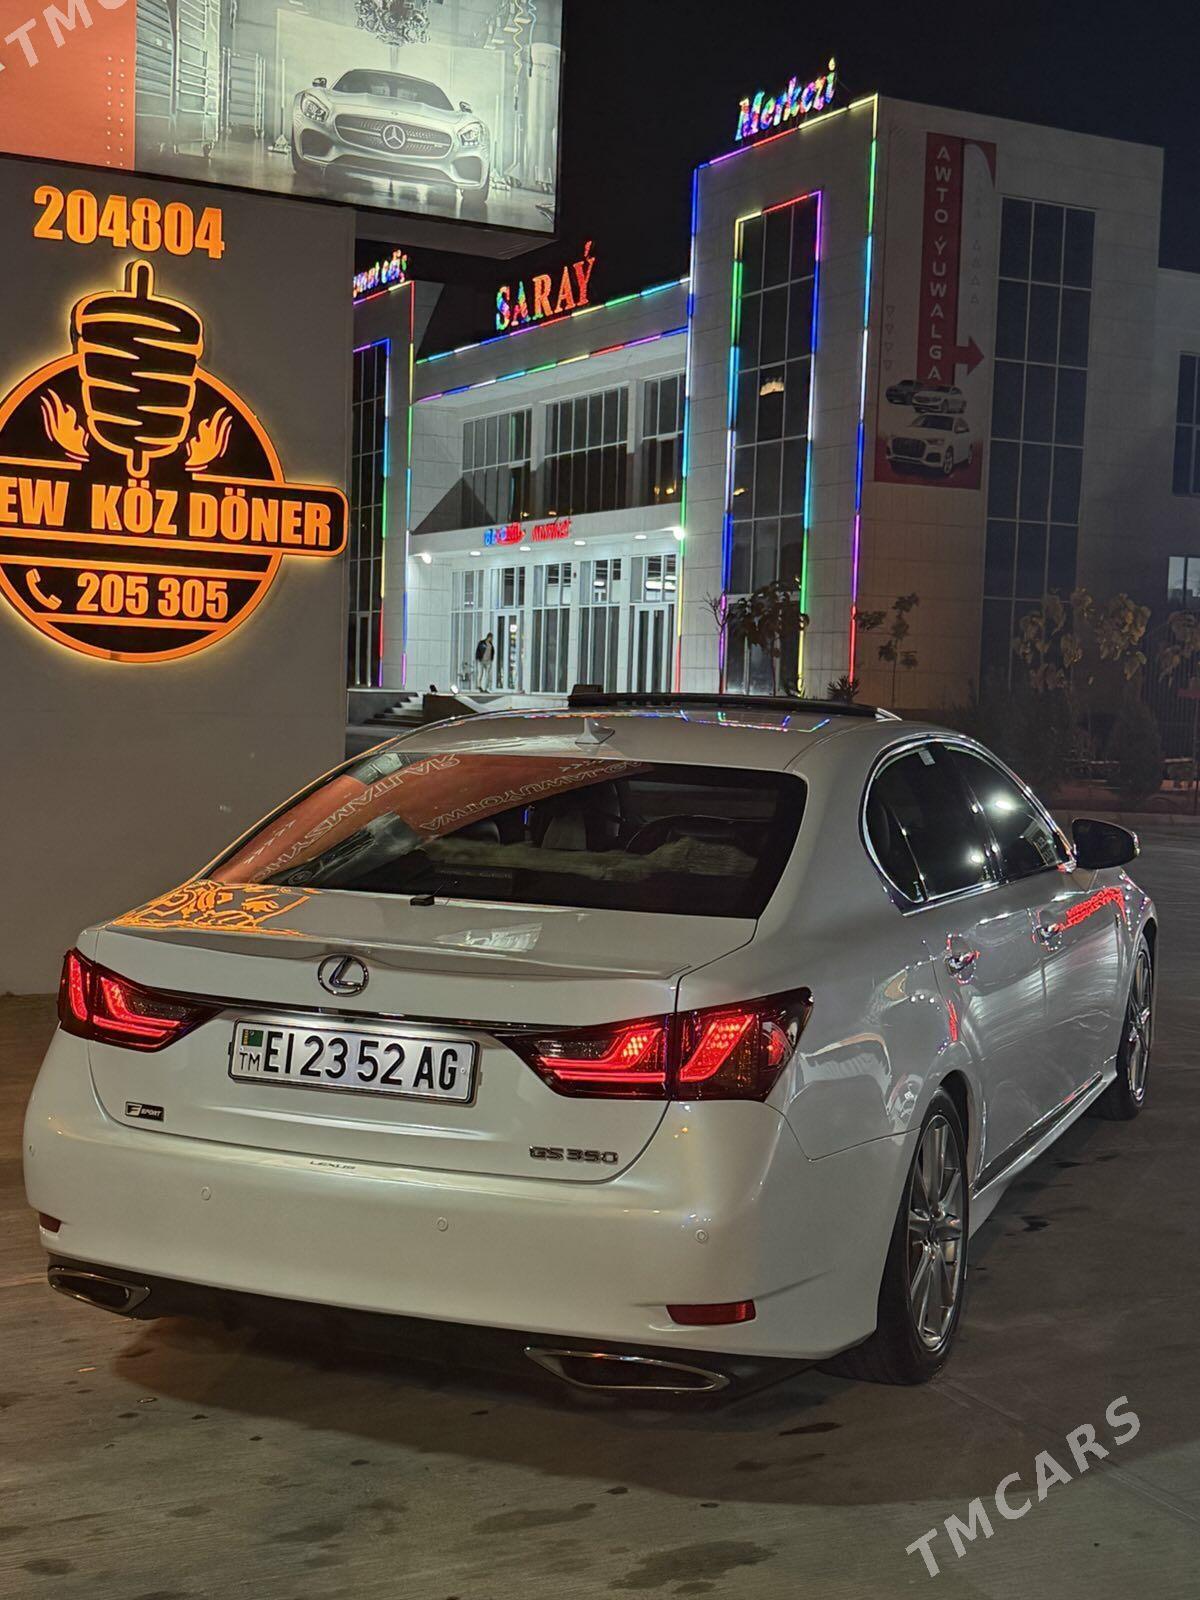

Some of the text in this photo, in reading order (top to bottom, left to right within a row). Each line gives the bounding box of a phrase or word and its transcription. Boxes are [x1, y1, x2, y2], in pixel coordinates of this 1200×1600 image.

[735, 57, 835, 141] Merkezi
[33, 184, 225, 259] 204804
[495, 240, 596, 331] SARAÝ
[927, 145, 952, 380] AWTO ÝUWALGA
[91, 479, 178, 535] KÖZ
[189, 487, 331, 547] DÖNER
[76, 571, 229, 620] 205 305
[529, 1146, 619, 1164] GS 350
